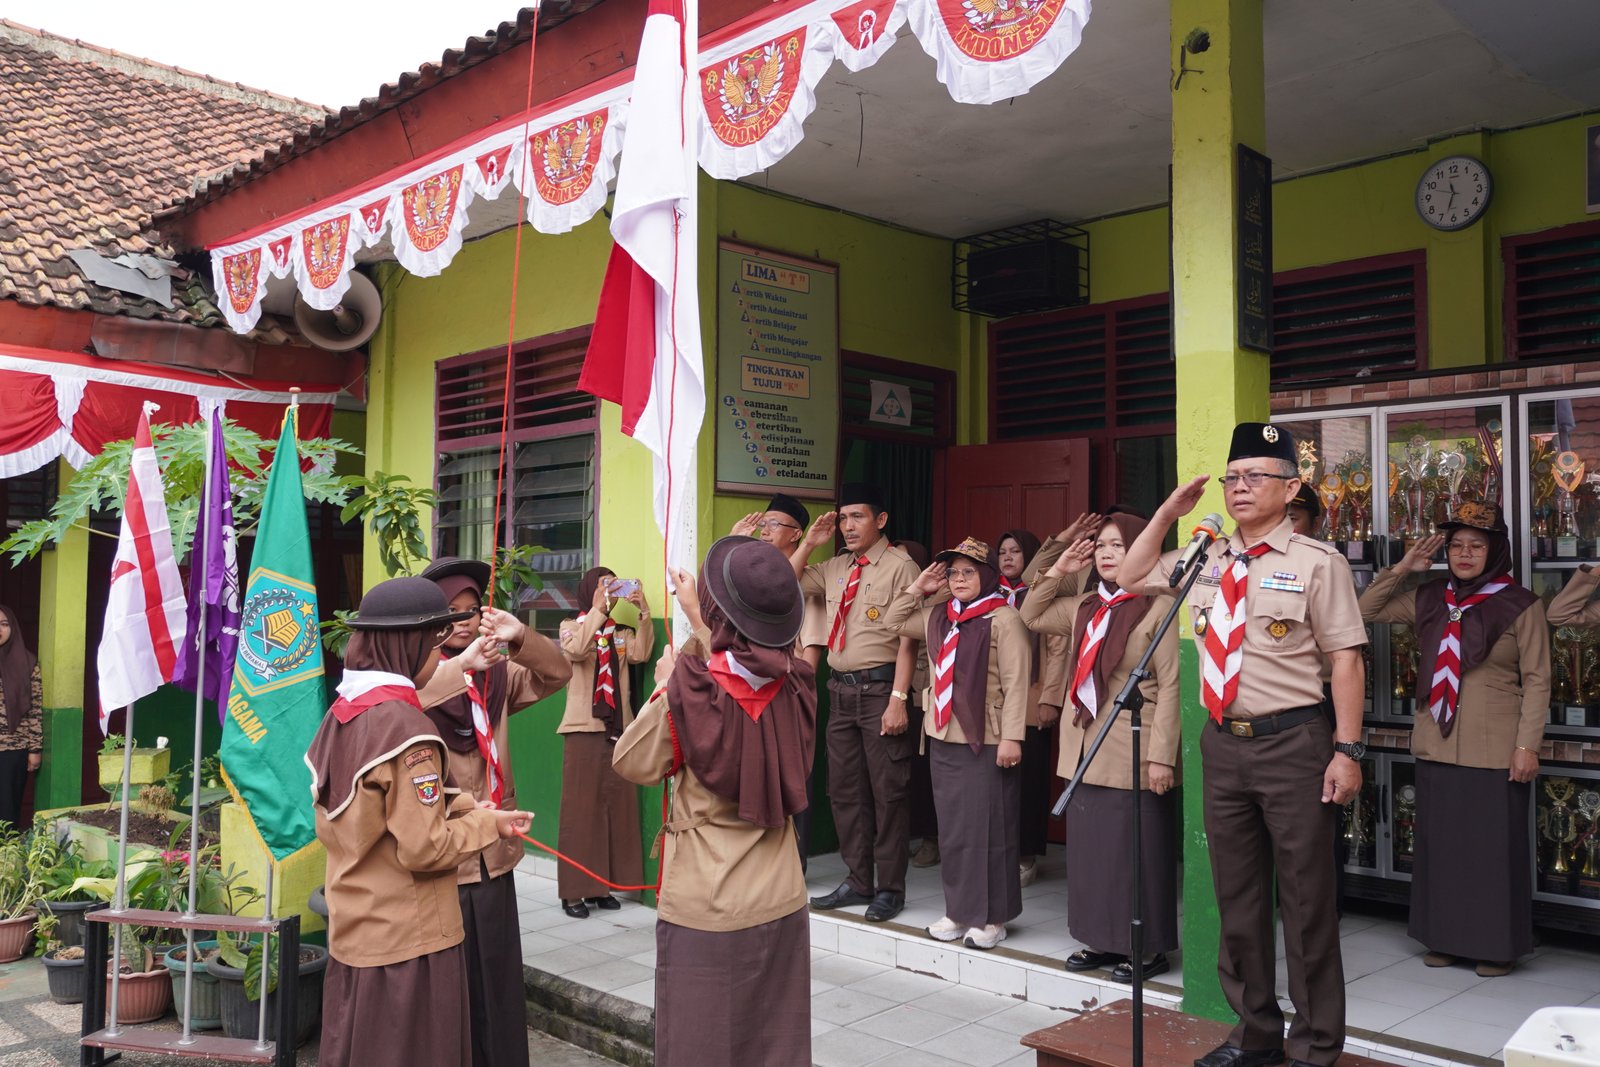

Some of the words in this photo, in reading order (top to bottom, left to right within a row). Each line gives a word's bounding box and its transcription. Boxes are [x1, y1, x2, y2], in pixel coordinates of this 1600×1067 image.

[714, 91, 791, 144] INDONESIA
[1436, 171, 1444, 179] 11
[1448, 164, 1458, 174] 12
[1464, 166, 1469, 174] 1
[1473, 173, 1479, 181] 2
[1427, 181, 1436, 190] 10
[1476, 184, 1482, 193] 3
[1425, 194, 1431, 202] 9
[1472, 197, 1478, 206] 4
[1428, 206, 1435, 214] 8
[1463, 208, 1469, 217] 5
[1438, 213, 1444, 221] 7
[1450, 214, 1457, 222] 6
[746, 263, 777, 281] LIMA
[742, 288, 763, 299] Tertib
[765, 292, 787, 303] Waktu
[746, 302, 767, 312] Tertib
[751, 316, 772, 326] Tertib
[773, 320, 797, 332] Belajar
[755, 330, 777, 341] Tertib
[778, 335, 808, 347] Mengajar
[760, 344, 781, 355] Tertib
[747, 363, 804, 379] TINGKATKAN
[752, 377, 782, 389] TUJUH
[737, 396, 788, 412] Keamanan
[742, 408, 798, 423] Kebersihan
[748, 420, 802, 434] Ketertiban
[753, 431, 815, 446] Kedisiplinan
[760, 443, 811, 457] Keindahan
[763, 455, 808, 468] Kerapian
[769, 467, 828, 481] Keteladanan
[227, 693, 268, 745] AGAMA
